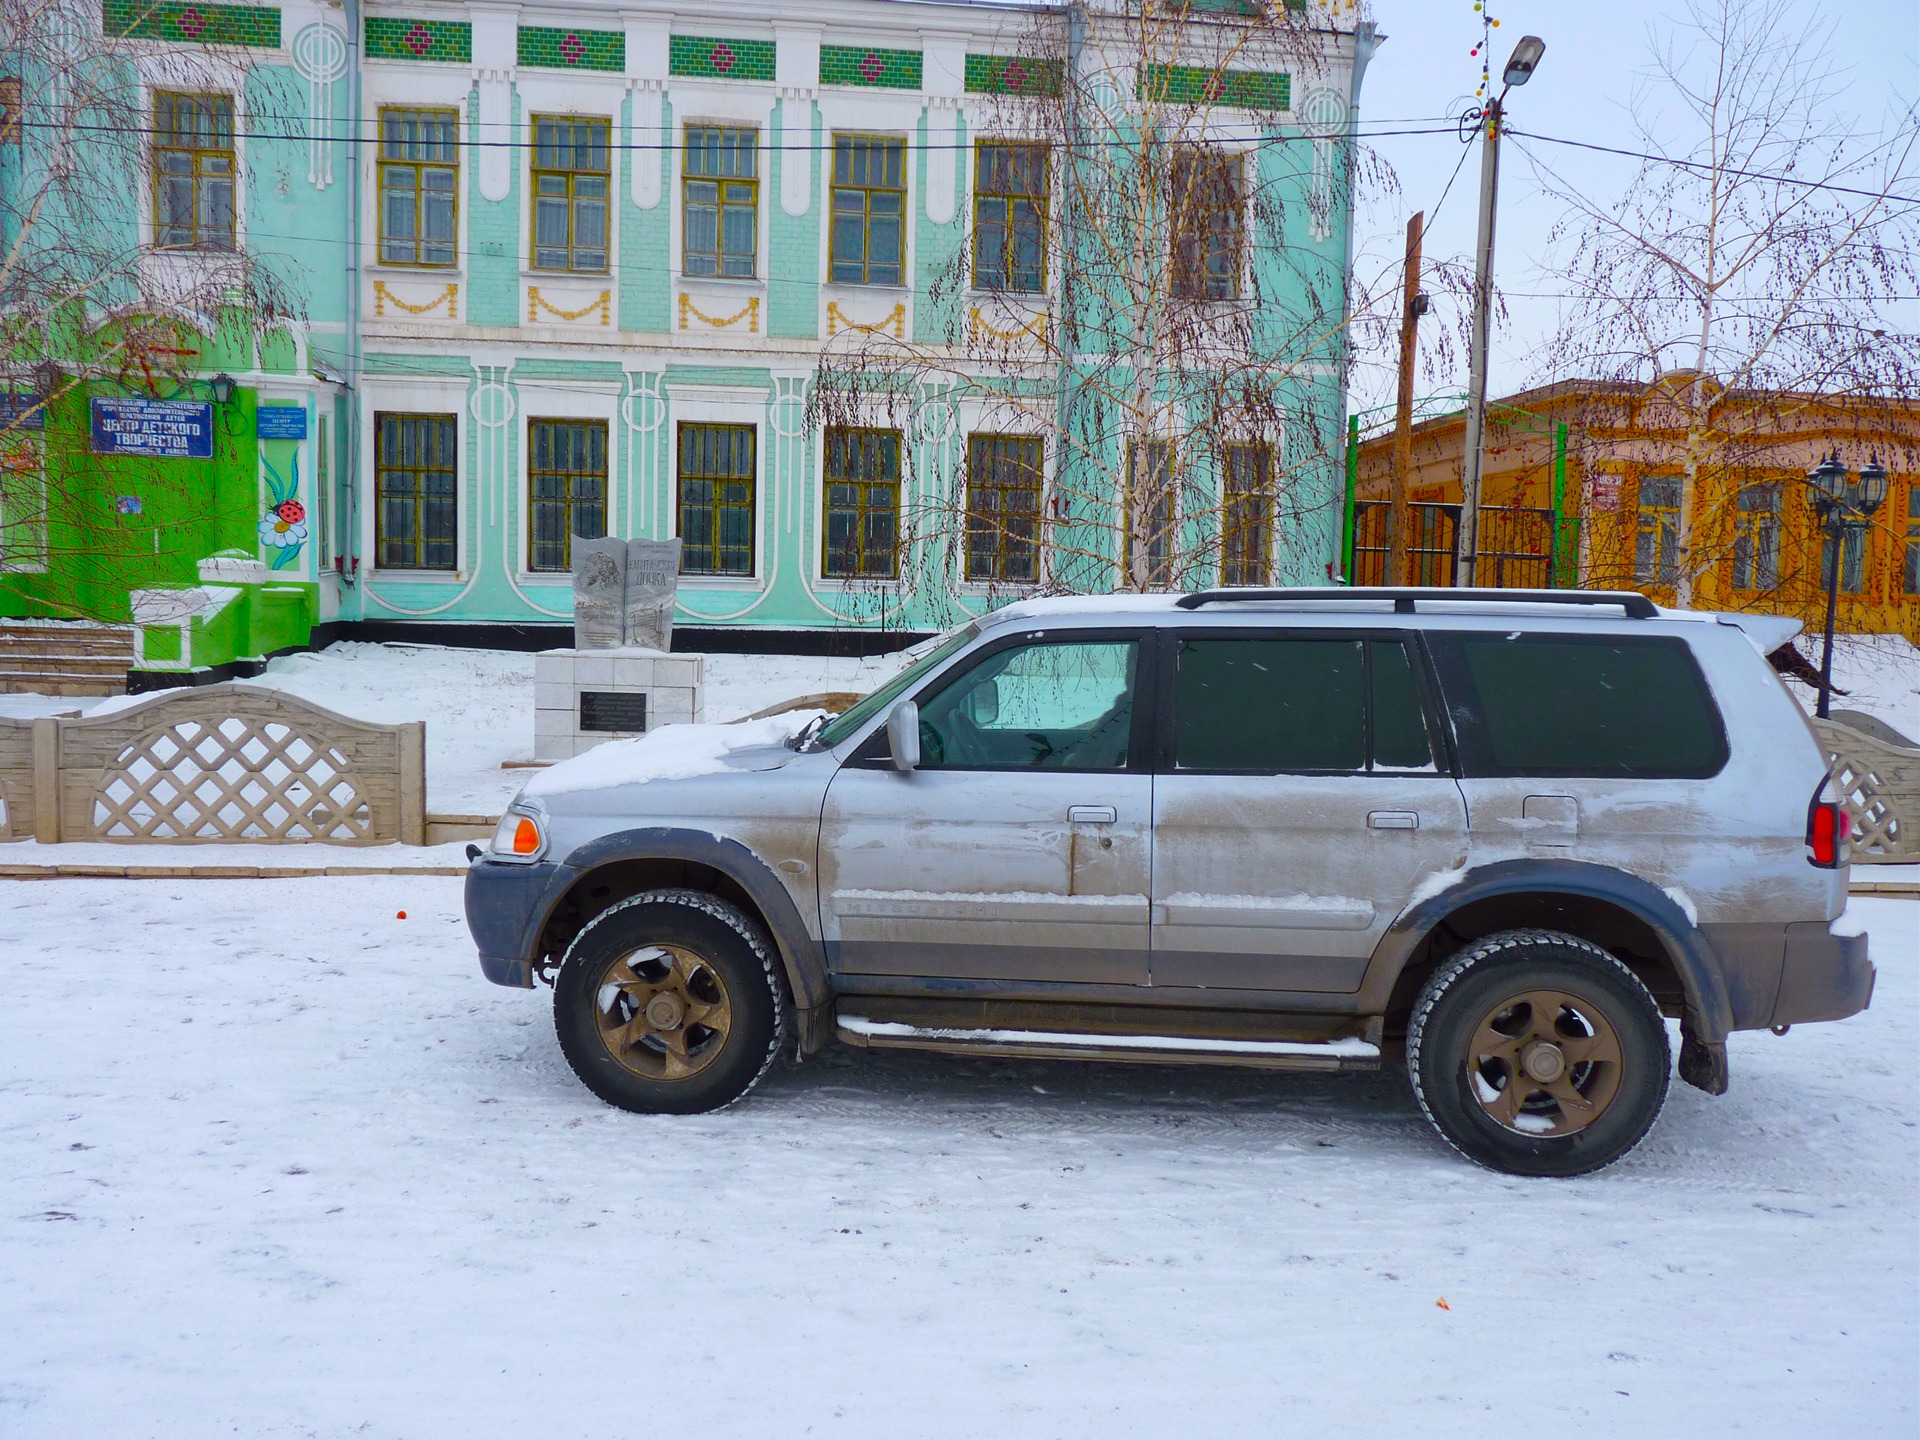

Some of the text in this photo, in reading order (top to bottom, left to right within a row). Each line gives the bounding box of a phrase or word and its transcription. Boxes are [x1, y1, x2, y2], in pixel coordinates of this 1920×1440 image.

[103, 419, 200, 436] ЦЕНТР ДЕТСКОГО
[115, 433, 188, 448] ТВОРЧЕСТВА
[635, 571, 666, 586] ДОЧКА
[846, 903, 998, 917] MITSUBISHI
